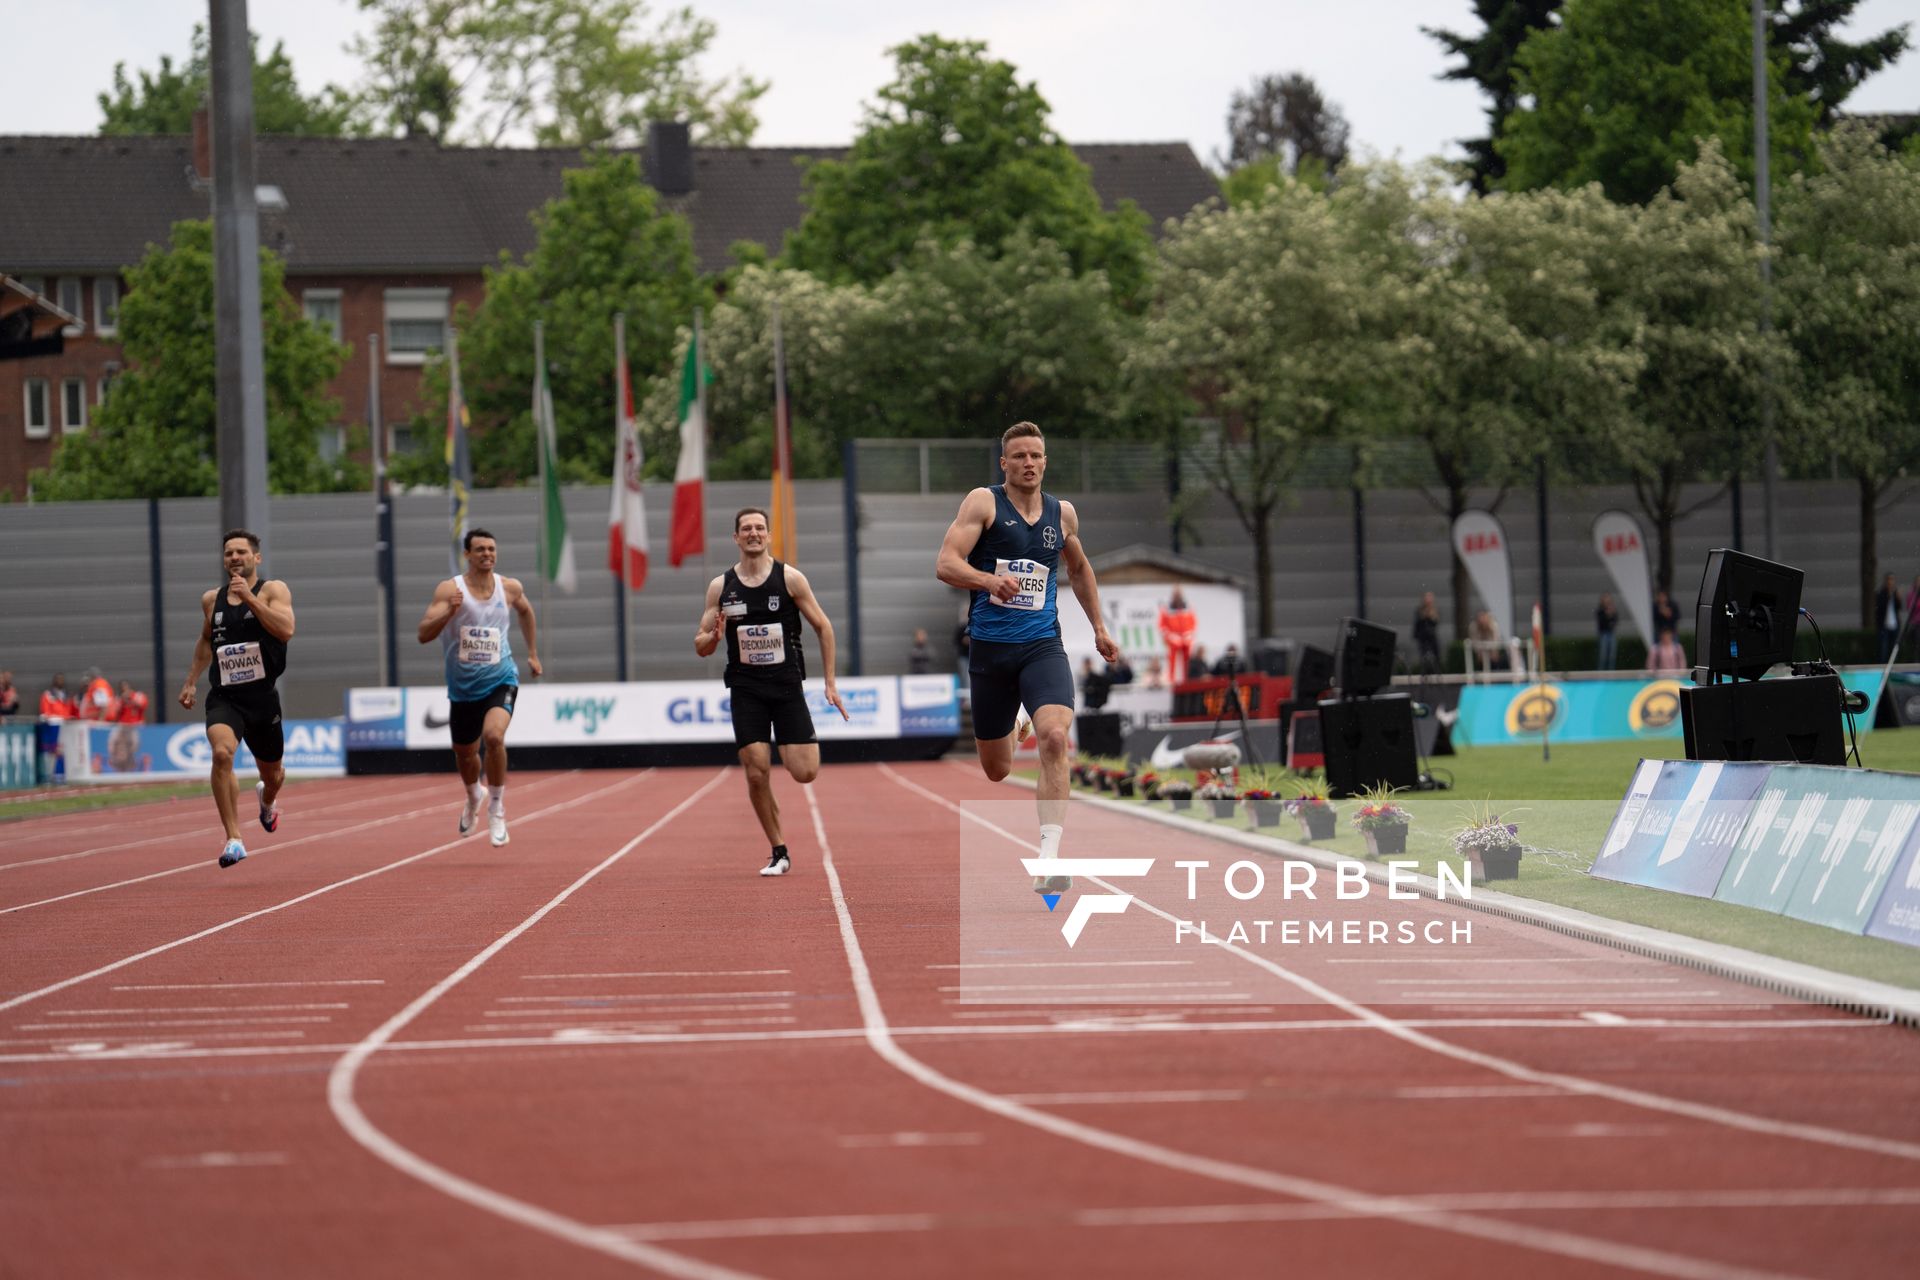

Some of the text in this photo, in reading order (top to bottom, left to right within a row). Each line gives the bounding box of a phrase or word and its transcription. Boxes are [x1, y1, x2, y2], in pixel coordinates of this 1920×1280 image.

[469, 628, 490, 637] GLS
[746, 627, 769, 636] GLS
[462, 639, 498, 651] BASTIEN
[741, 638, 781, 650] DIECKMANN
[224, 645, 246, 656] GLS
[221, 655, 260, 670] NOWAK
[554, 698, 616, 734] wgv
